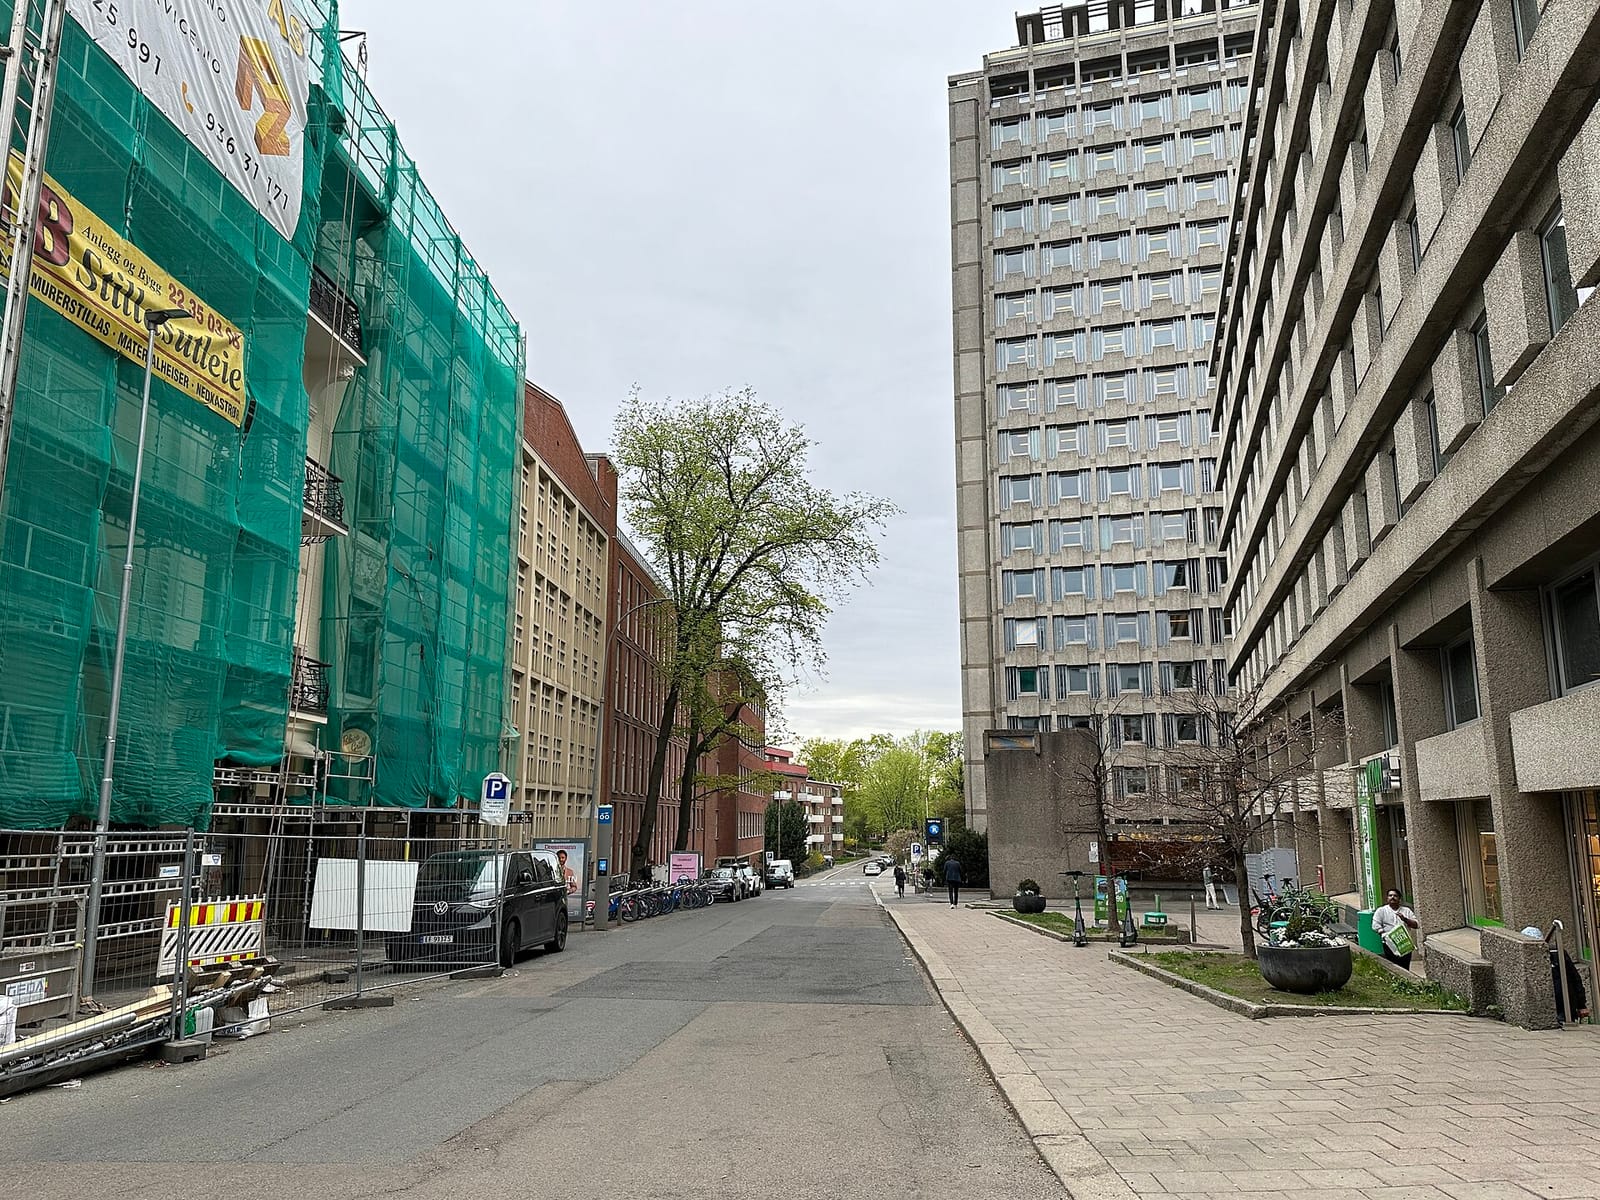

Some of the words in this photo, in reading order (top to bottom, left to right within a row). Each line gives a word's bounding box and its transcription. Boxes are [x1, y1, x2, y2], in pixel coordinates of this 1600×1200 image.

[127, 28, 161, 75] 991
[206, 112, 236, 155] 936
[243, 154, 259, 180] 31
[266, 176, 289, 210] 171
[81, 225, 122, 266] Anlegg
[123, 257, 136, 275] og
[137, 267, 162, 296] Bygg
[30, 271, 111, 337] MURERSTILLAS
[117, 331, 189, 389] MATERALHEISER
[76, 248, 241, 392] Stillsutleie
[168, 282, 185, 309] 22
[189, 298, 204, 325] 35
[207, 313, 224, 338] 03
[490, 781, 503, 797] P
